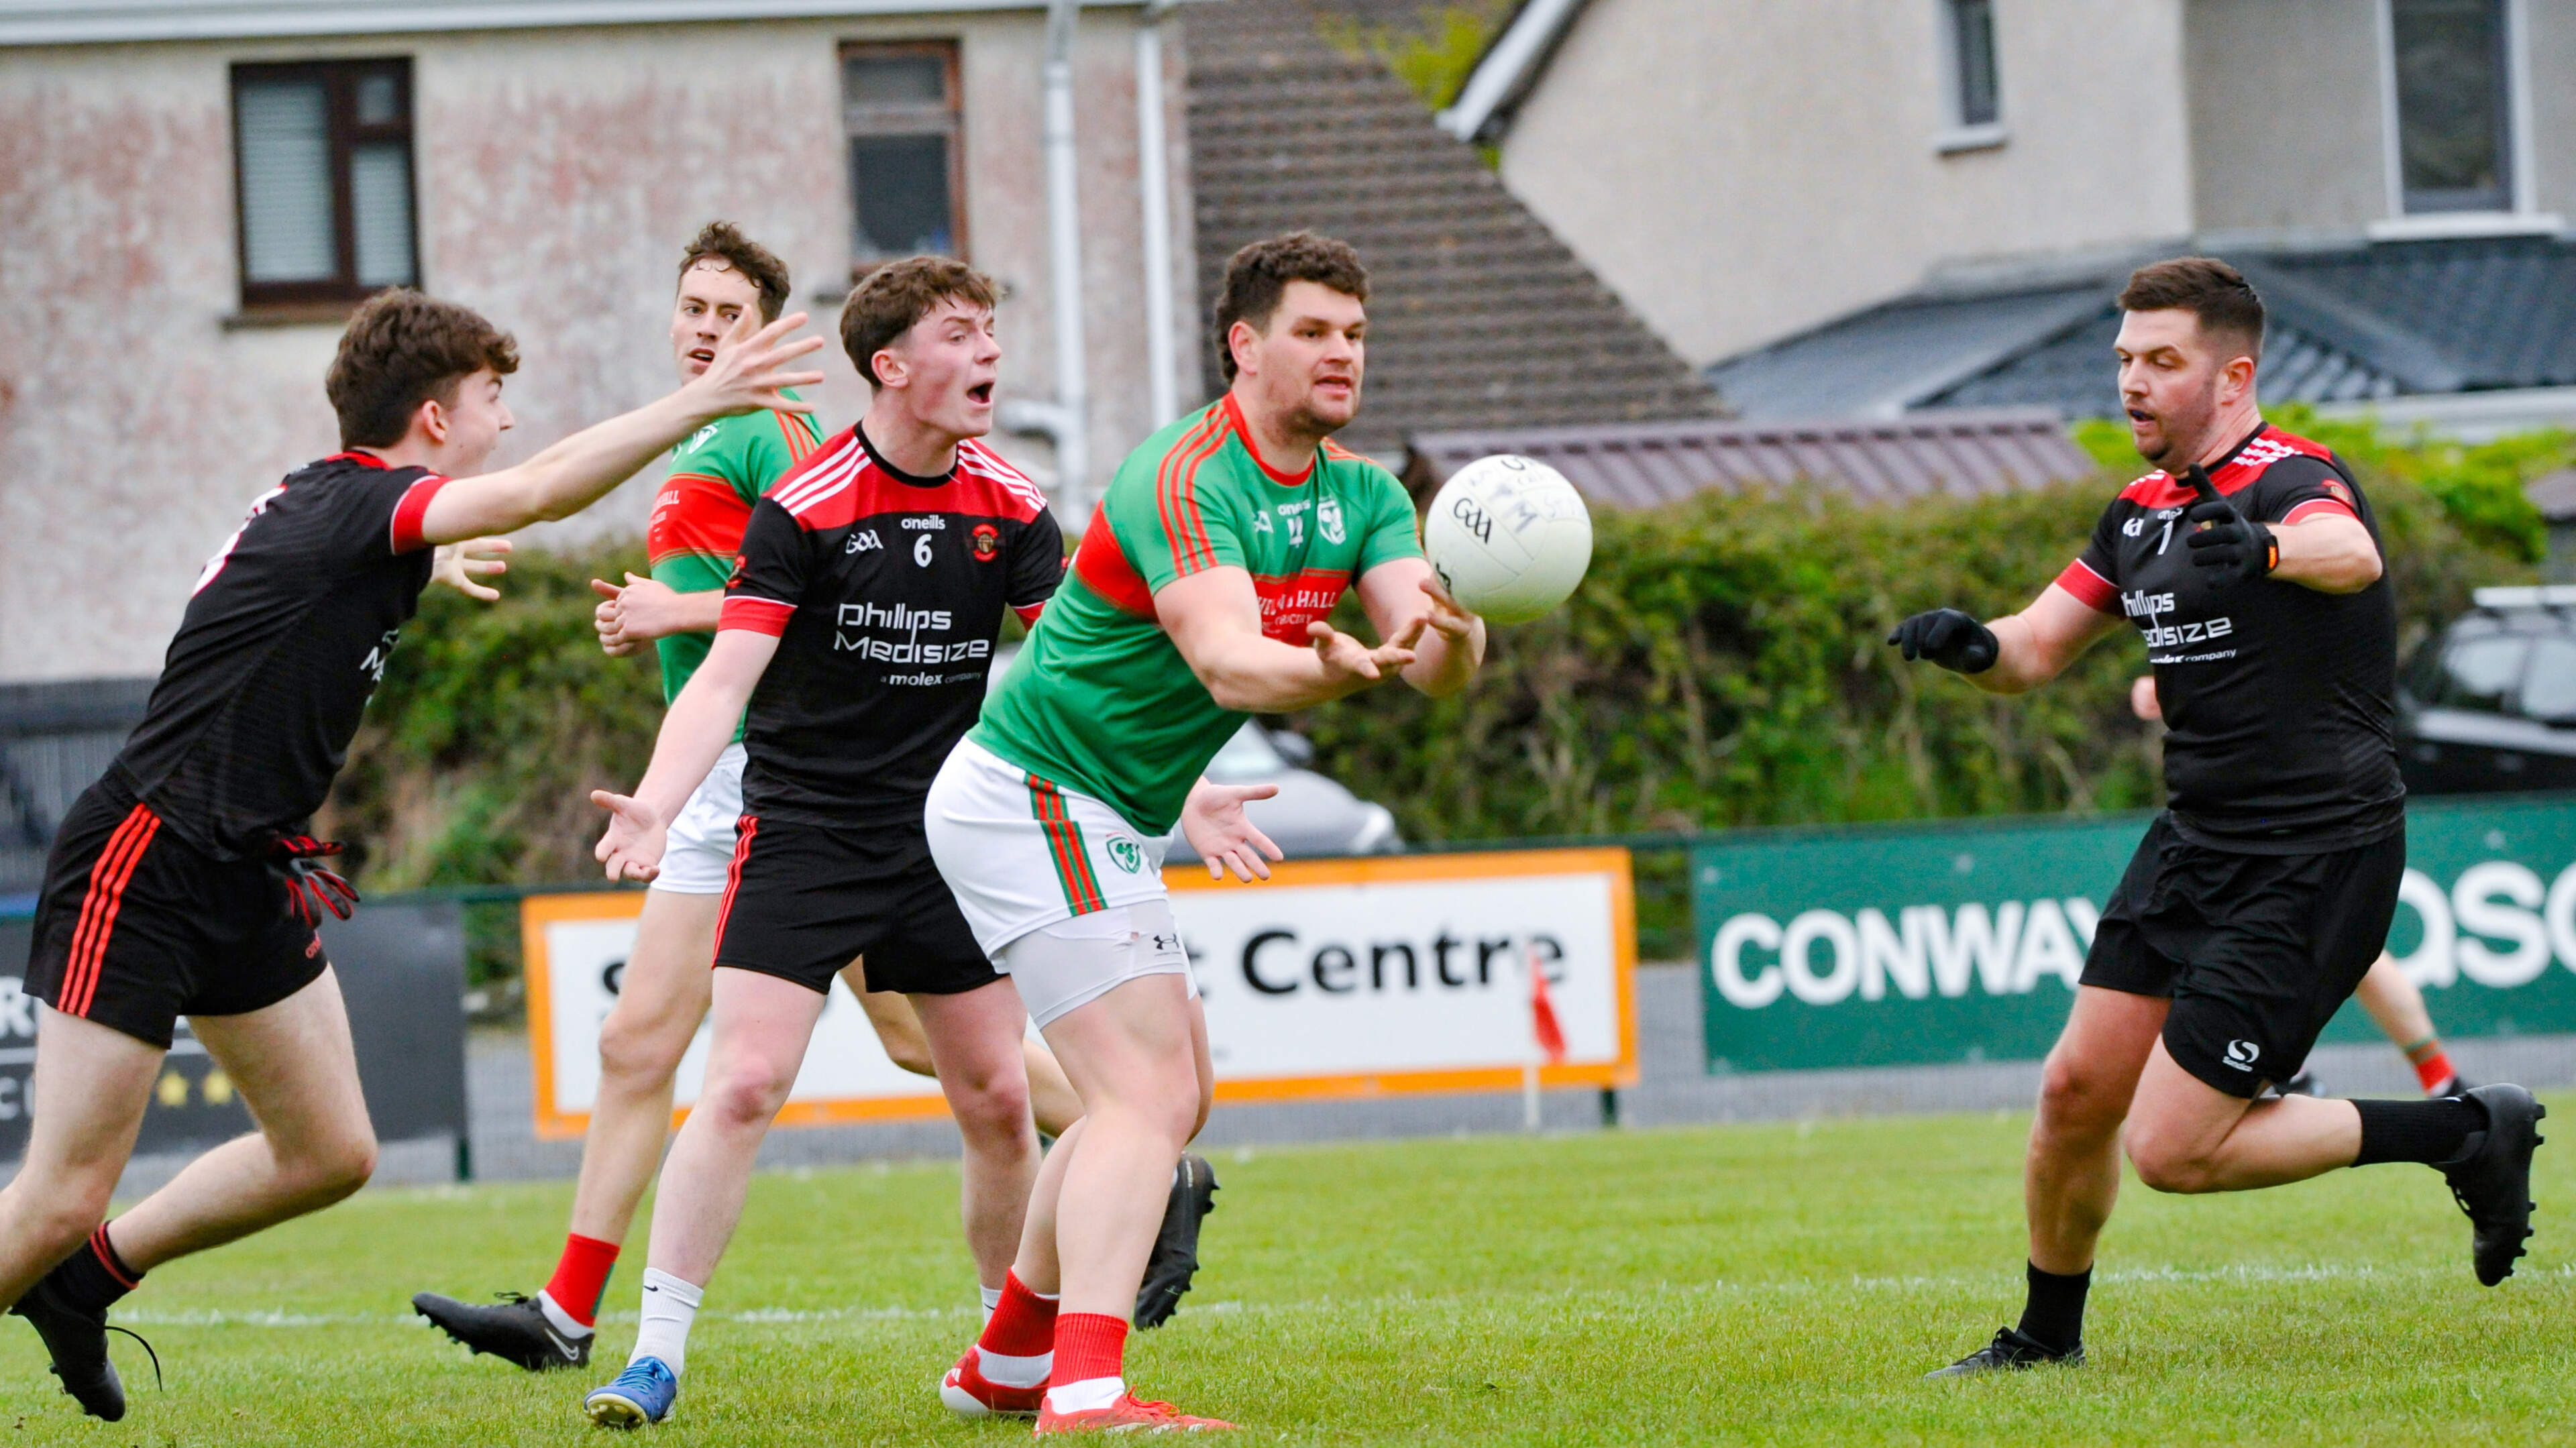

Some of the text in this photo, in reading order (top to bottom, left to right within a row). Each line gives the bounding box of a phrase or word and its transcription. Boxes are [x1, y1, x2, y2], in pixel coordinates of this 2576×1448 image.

[914, 533, 932, 568] 6
[1295, 590, 1336, 608] HALL
[2121, 590, 2176, 618] hillips
[2141, 616, 2233, 648] edisize
[833, 630, 989, 664] Medisize
[2185, 648, 2237, 662] company
[889, 671, 943, 686] molex
